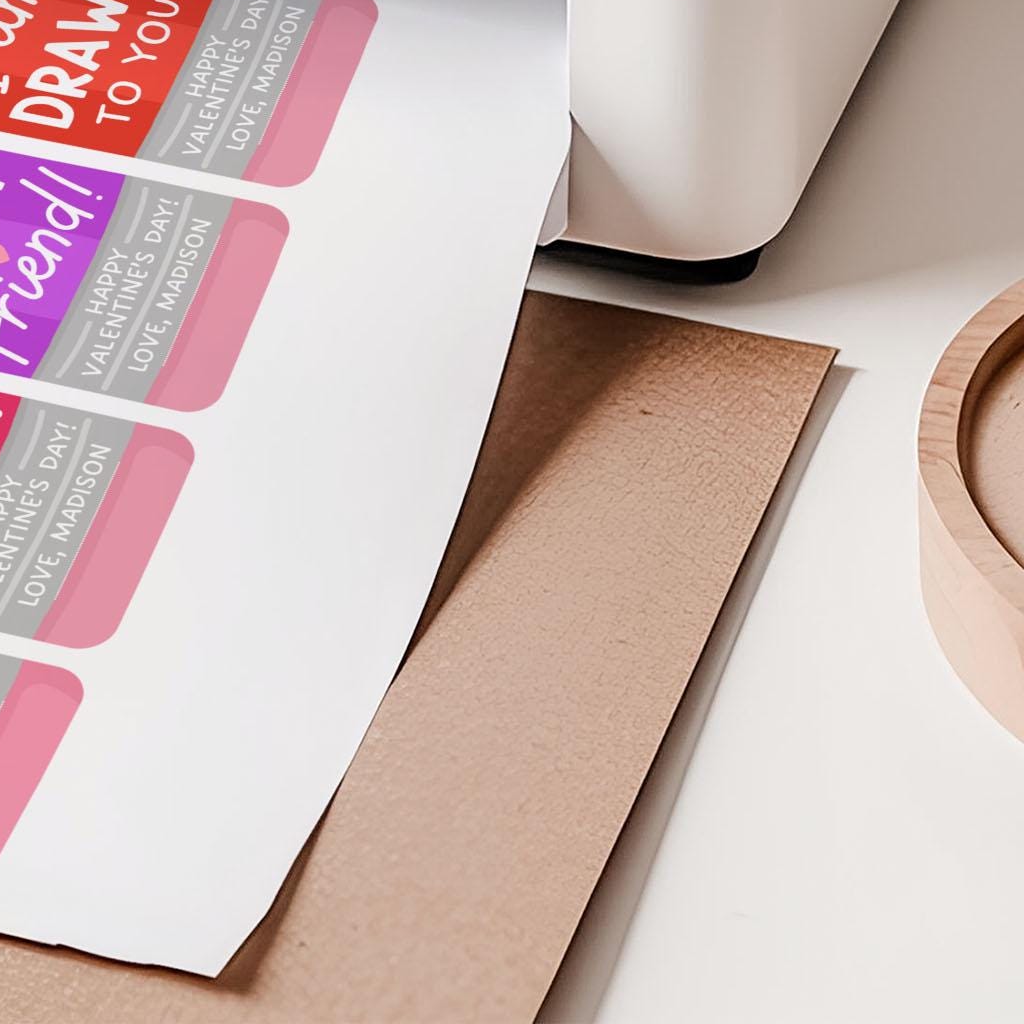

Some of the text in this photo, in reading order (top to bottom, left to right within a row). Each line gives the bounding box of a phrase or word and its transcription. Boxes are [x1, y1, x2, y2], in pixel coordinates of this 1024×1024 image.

[96, 80, 142, 125] TO
[182, 34, 251, 156] VALENTINE'S
[185, 34, 228, 99] HAPPY
[225, 5, 306, 152] LOVE, MADISON
[81, 197, 179, 378] VALENTINE'S DAY!
[86, 247, 129, 315] HAPPY
[128, 218, 212, 373] LOVE, MADISON
[39, 421, 78, 470] DAY!
[17, 443, 111, 608] LOVE, MADISON
